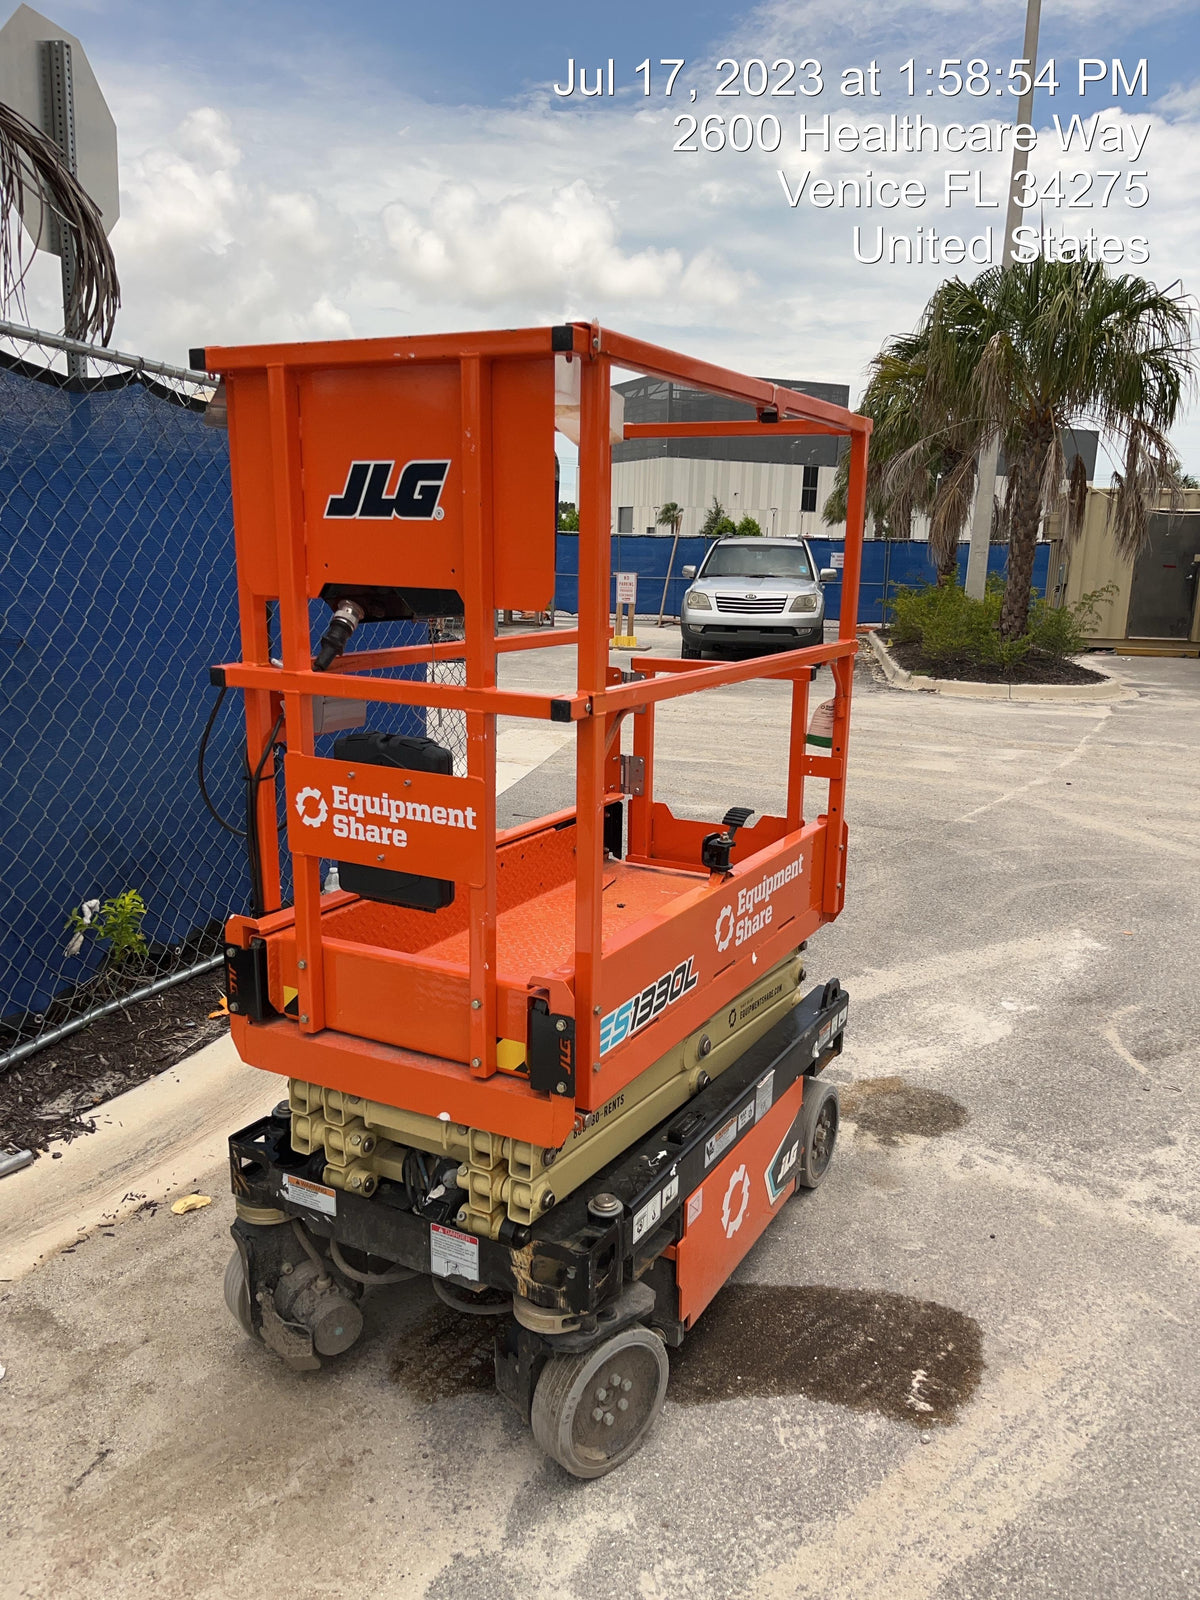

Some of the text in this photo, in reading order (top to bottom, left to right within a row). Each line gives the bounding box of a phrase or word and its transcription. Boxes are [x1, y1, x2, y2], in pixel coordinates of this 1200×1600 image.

[323, 459, 452, 520] JLG
[332, 785, 477, 830] Equipment
[332, 814, 408, 848] Share
[737, 853, 804, 917] Equipment
[735, 905, 773, 947] Share
[600, 954, 699, 1057] ES1330L
[559, 1038, 571, 1076] JLG
[776, 1140, 799, 1184] JLG
